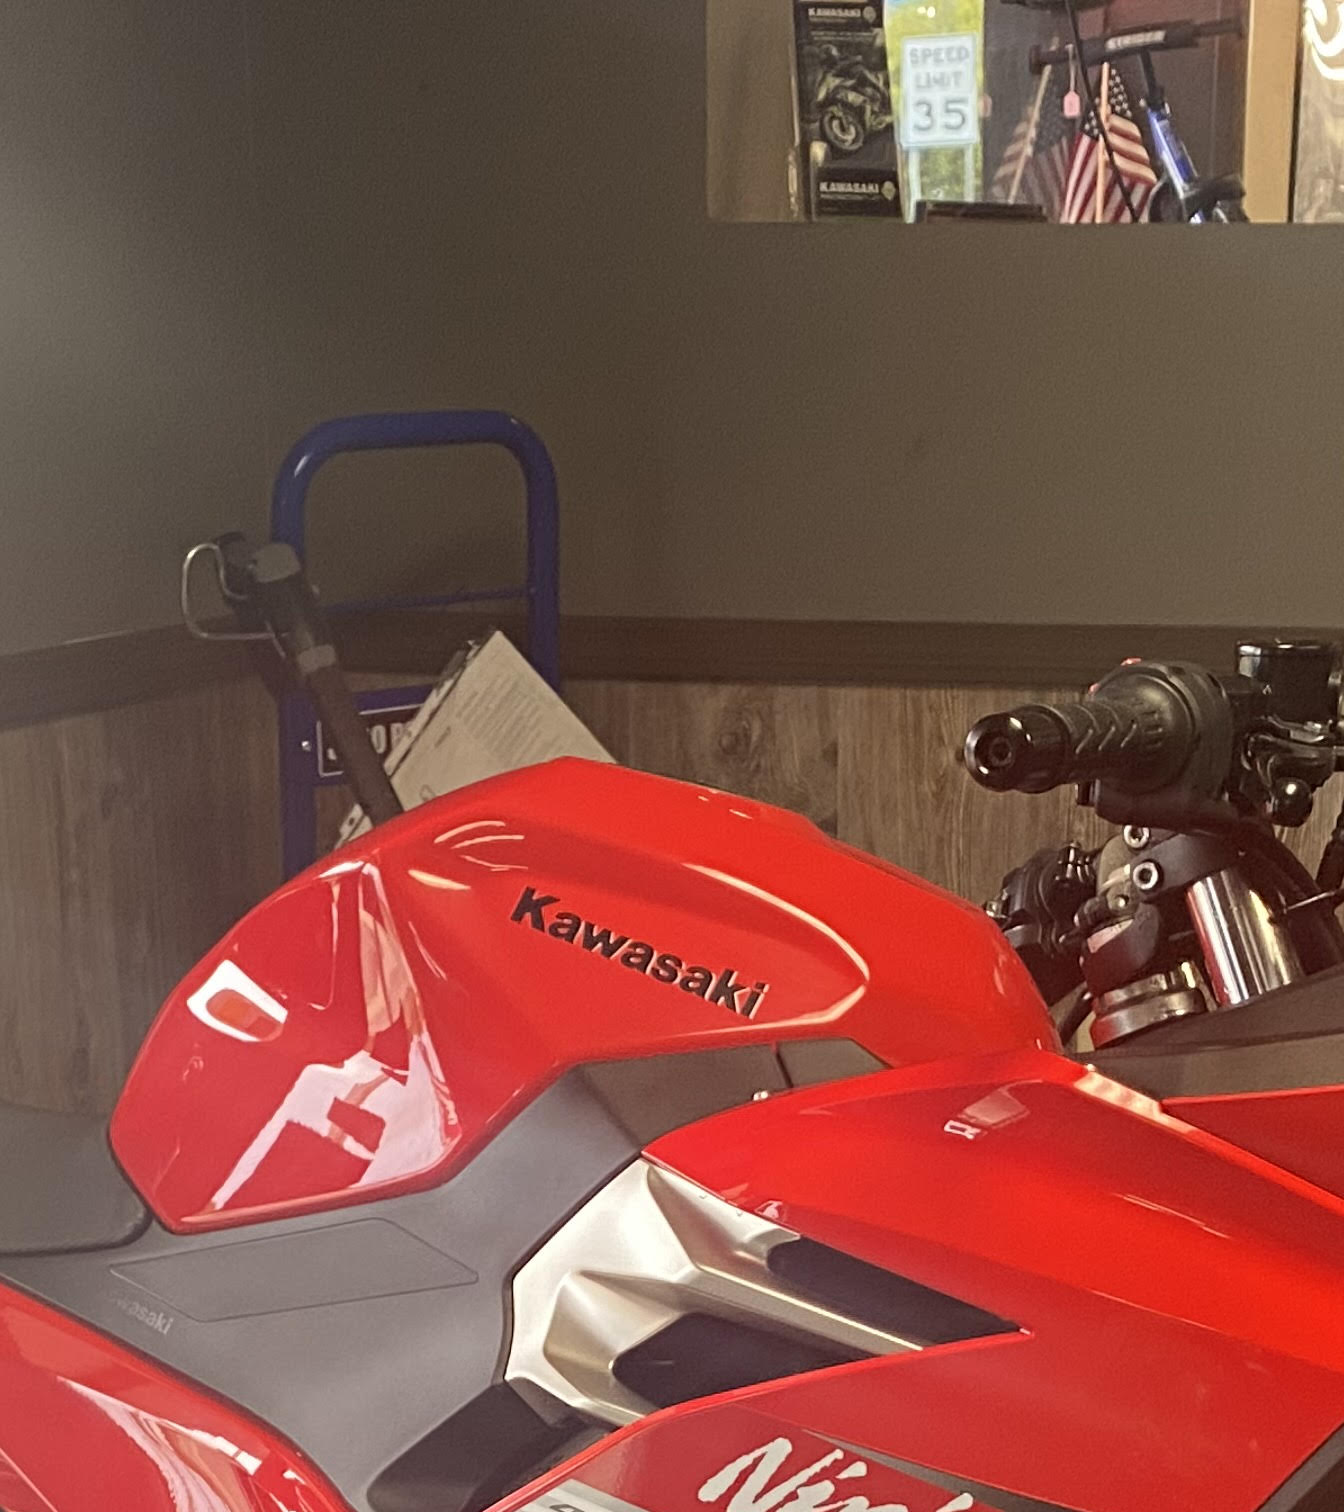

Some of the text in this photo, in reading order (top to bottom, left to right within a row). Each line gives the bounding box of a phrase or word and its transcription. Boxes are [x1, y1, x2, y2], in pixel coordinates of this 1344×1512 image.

[808, 7, 862, 18] KAWASAKI
[909, 46, 971, 65] SPEED
[915, 71, 963, 89] LIMIT
[913, 98, 969, 131] 35
[819, 181, 880, 193] KAWASAKI
[510, 885, 770, 1020] Kawasaki
